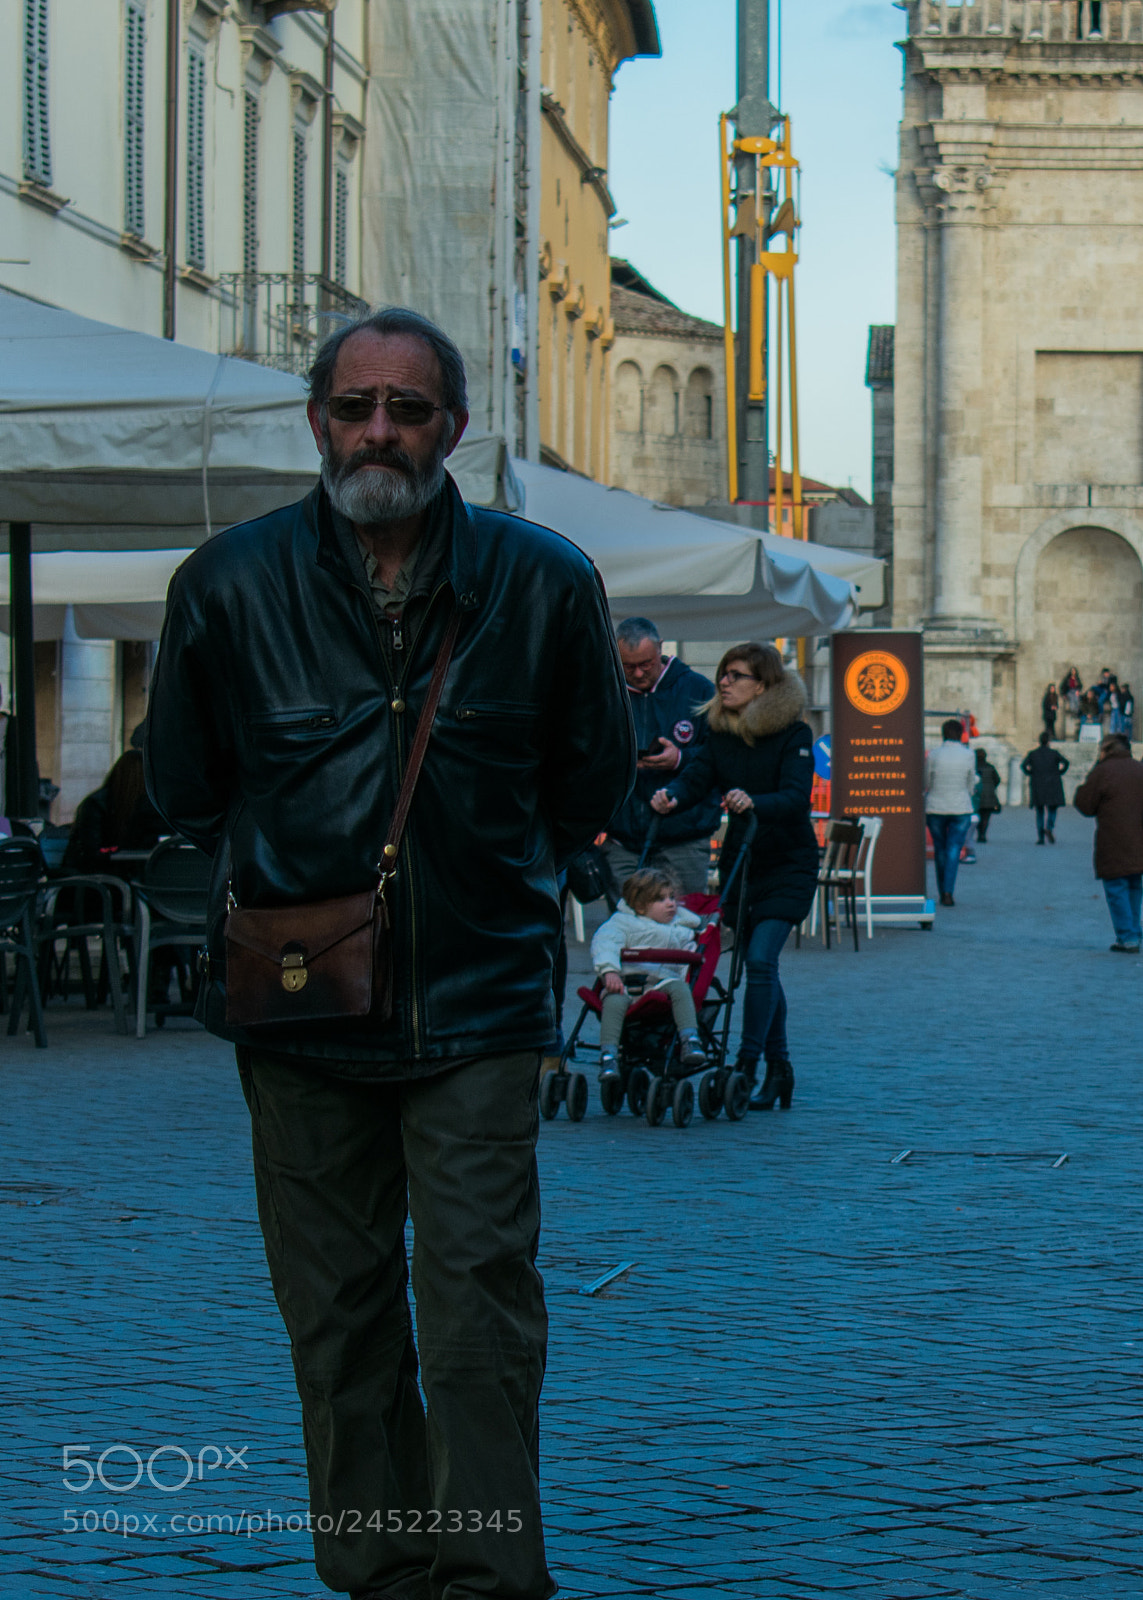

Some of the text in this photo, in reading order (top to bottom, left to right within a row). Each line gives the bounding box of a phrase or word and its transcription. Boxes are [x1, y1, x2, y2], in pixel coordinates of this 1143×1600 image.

[850, 738, 904, 746] YOGURTERIA
[854, 755, 900, 763] GELATERIA
[848, 772, 906, 780] CAFFETTERIA
[850, 789, 905, 797] PASTICCERIA
[844, 806, 911, 814] CIOCCOLATERIA
